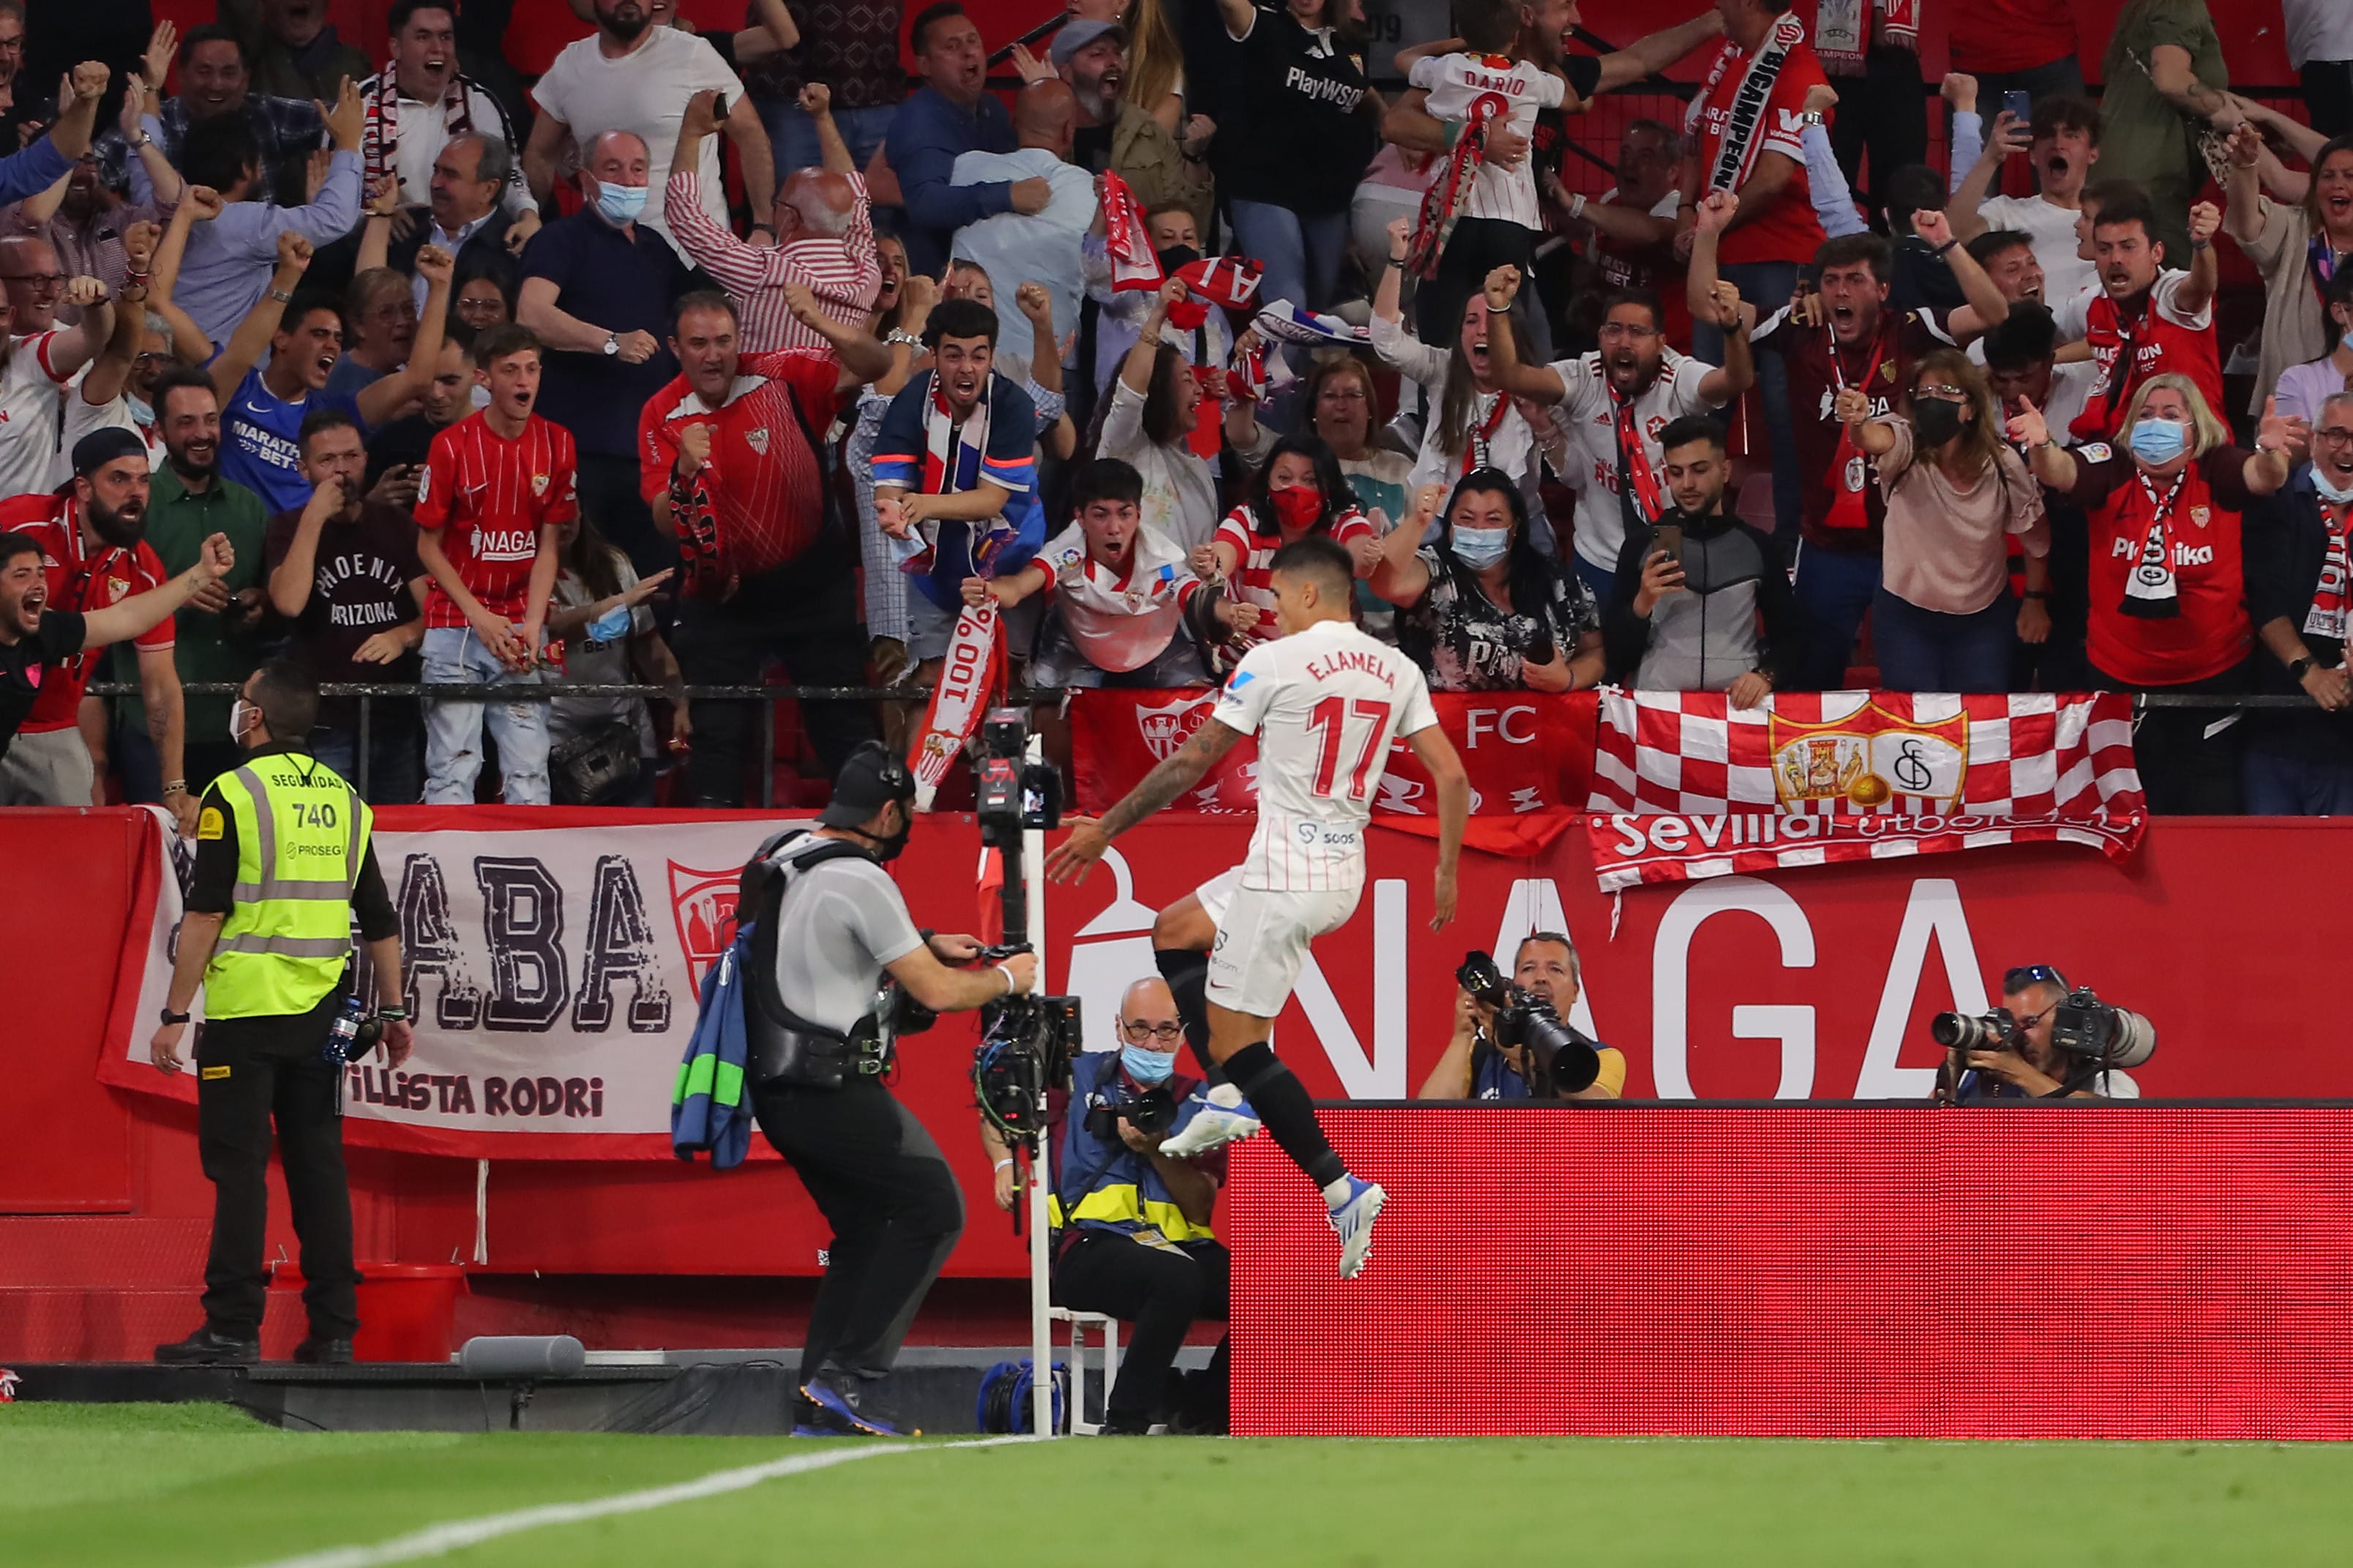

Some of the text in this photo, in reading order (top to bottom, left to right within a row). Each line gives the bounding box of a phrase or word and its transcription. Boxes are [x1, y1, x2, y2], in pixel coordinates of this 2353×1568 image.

[1464, 71, 1526, 96] DARIO
[259, 446, 293, 469] BET
[482, 530, 536, 552] NAGA
[316, 554, 404, 599] PHOENIX
[331, 601, 398, 626] ARIZONA
[944, 609, 992, 703] 100%
[1306, 650, 1395, 690] E.LAMELA
[1467, 705, 1536, 749] FC
[1306, 696, 1391, 802] 17
[292, 803, 337, 829] 740
[1612, 814, 1821, 856] Sevilla
